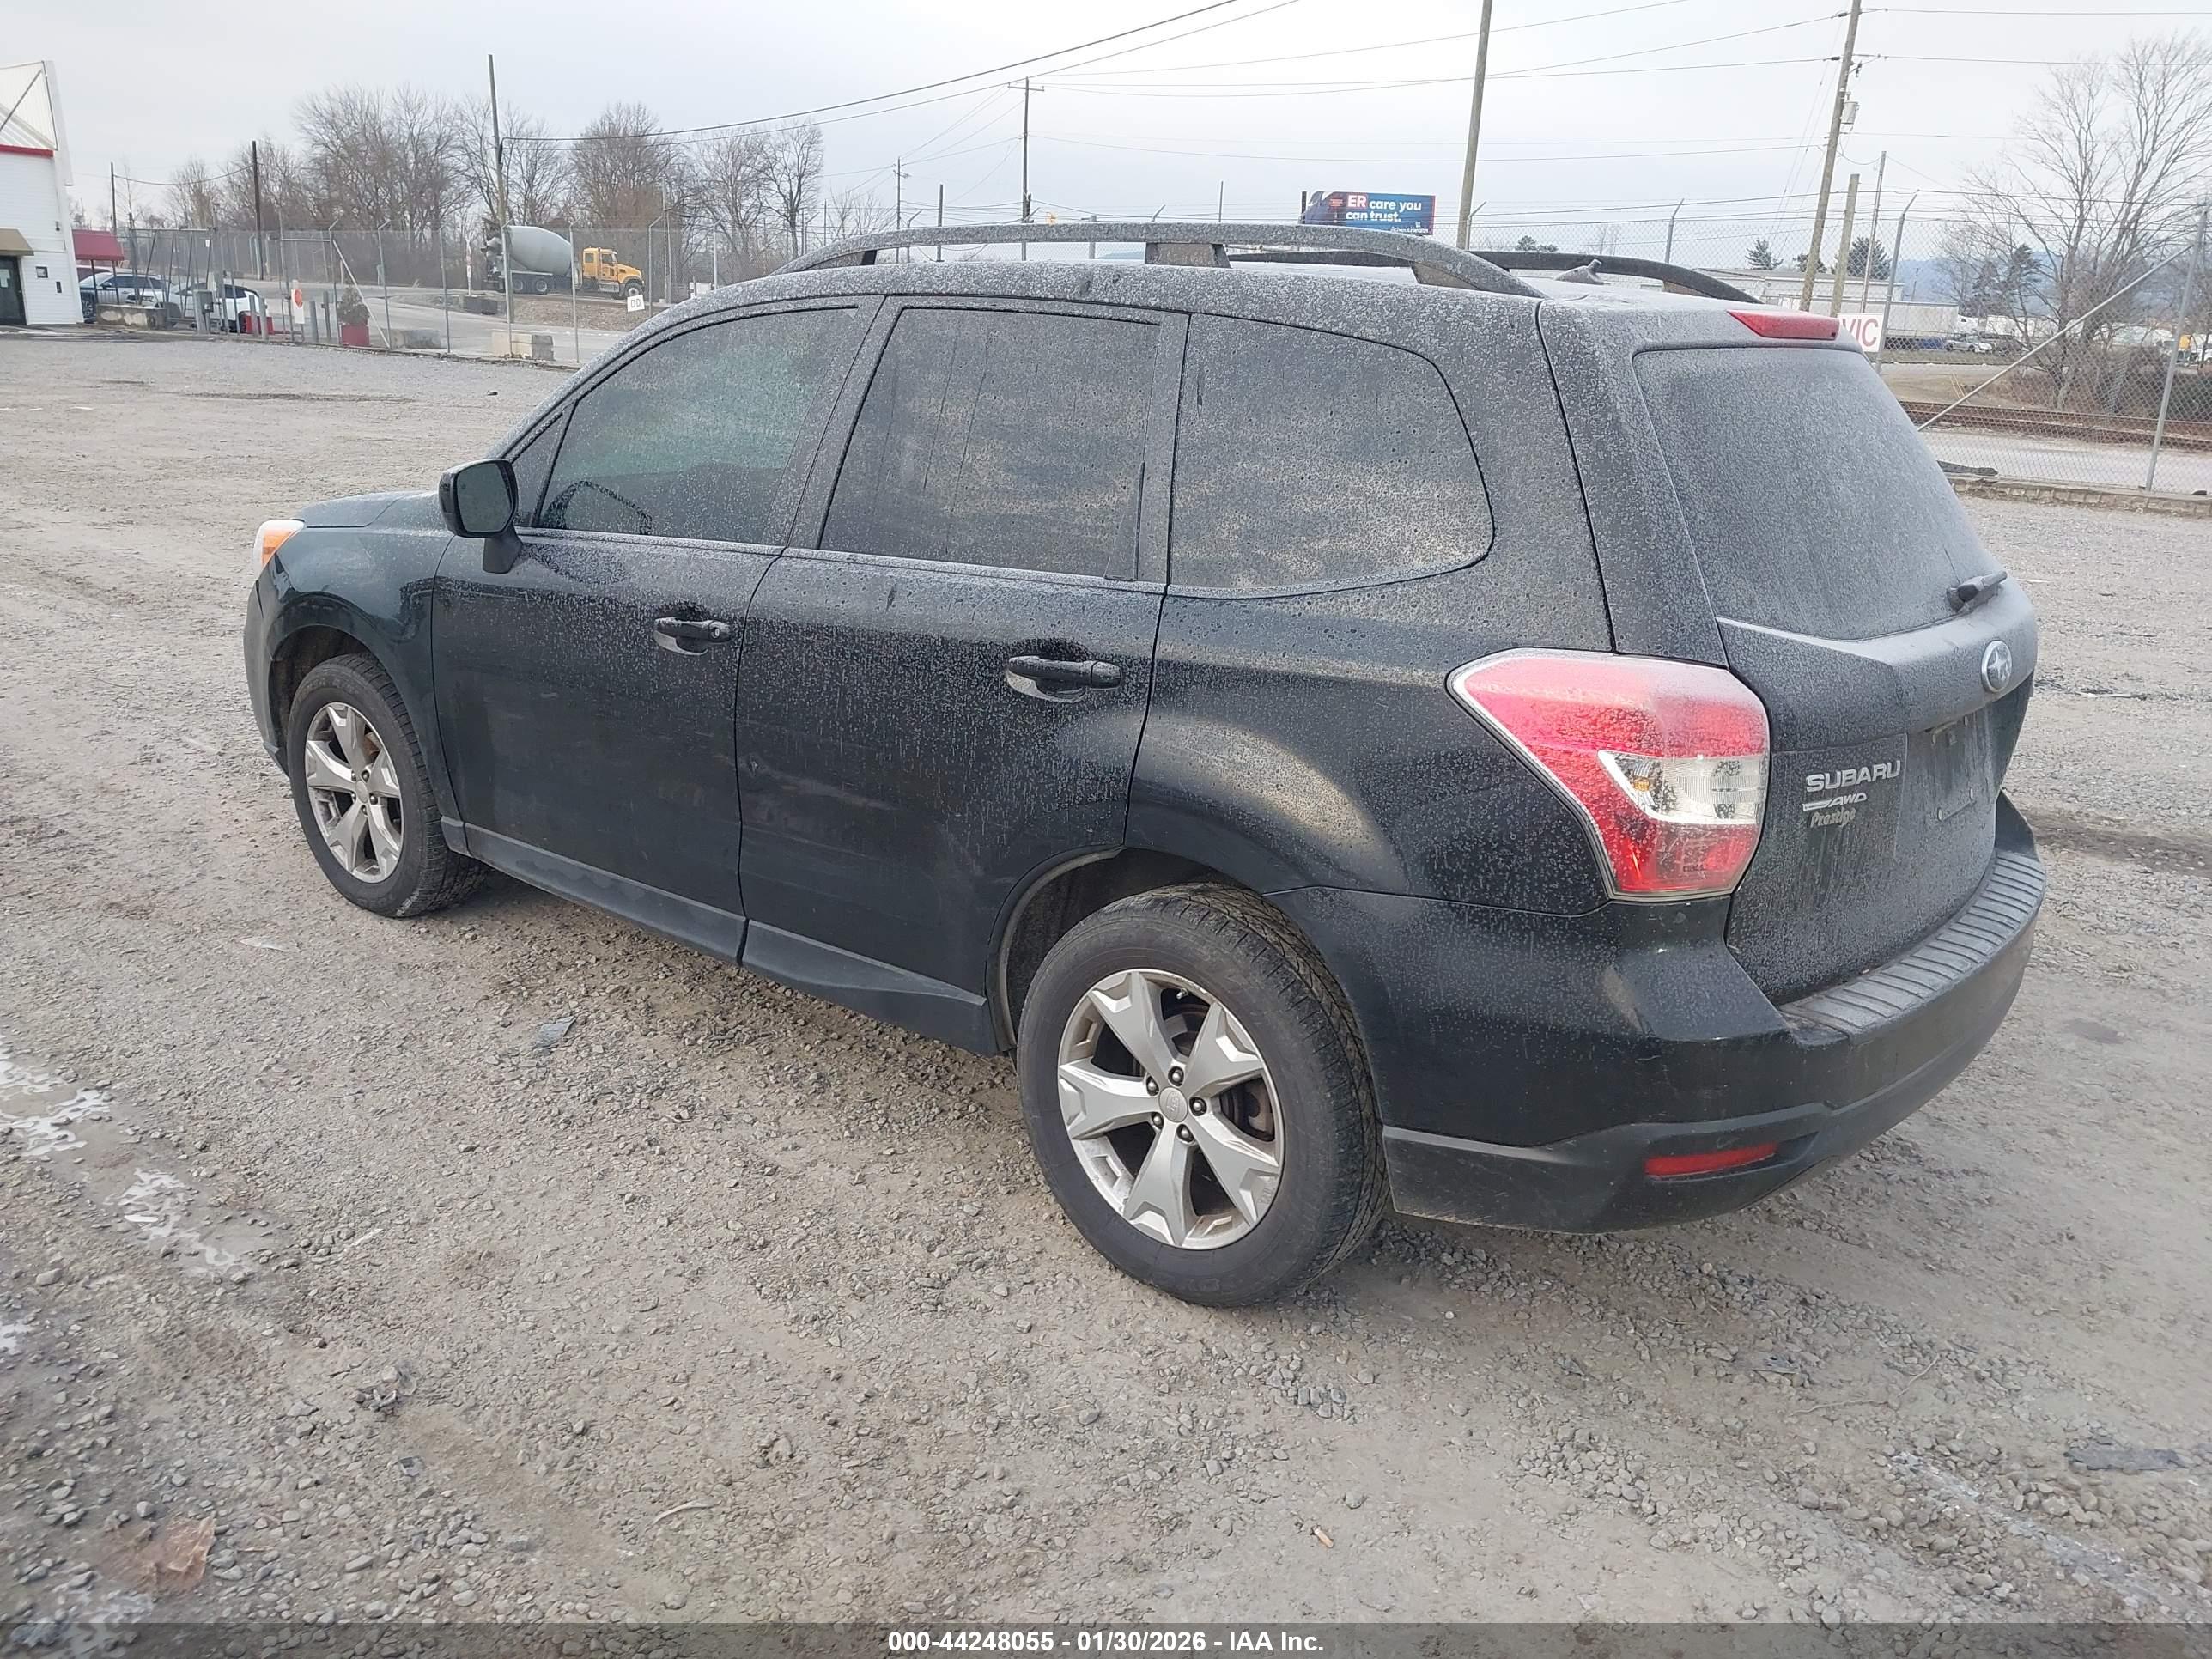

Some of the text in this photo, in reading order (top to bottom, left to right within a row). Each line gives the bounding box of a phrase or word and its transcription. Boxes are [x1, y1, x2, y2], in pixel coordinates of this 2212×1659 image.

[1347, 195, 1422, 213] ER care you
[1346, 210, 1401, 222] can trust.
[1805, 760, 1901, 793] SUBARU
[1827, 792, 1868, 808] AWD
[1810, 806, 1856, 828] Prestige
